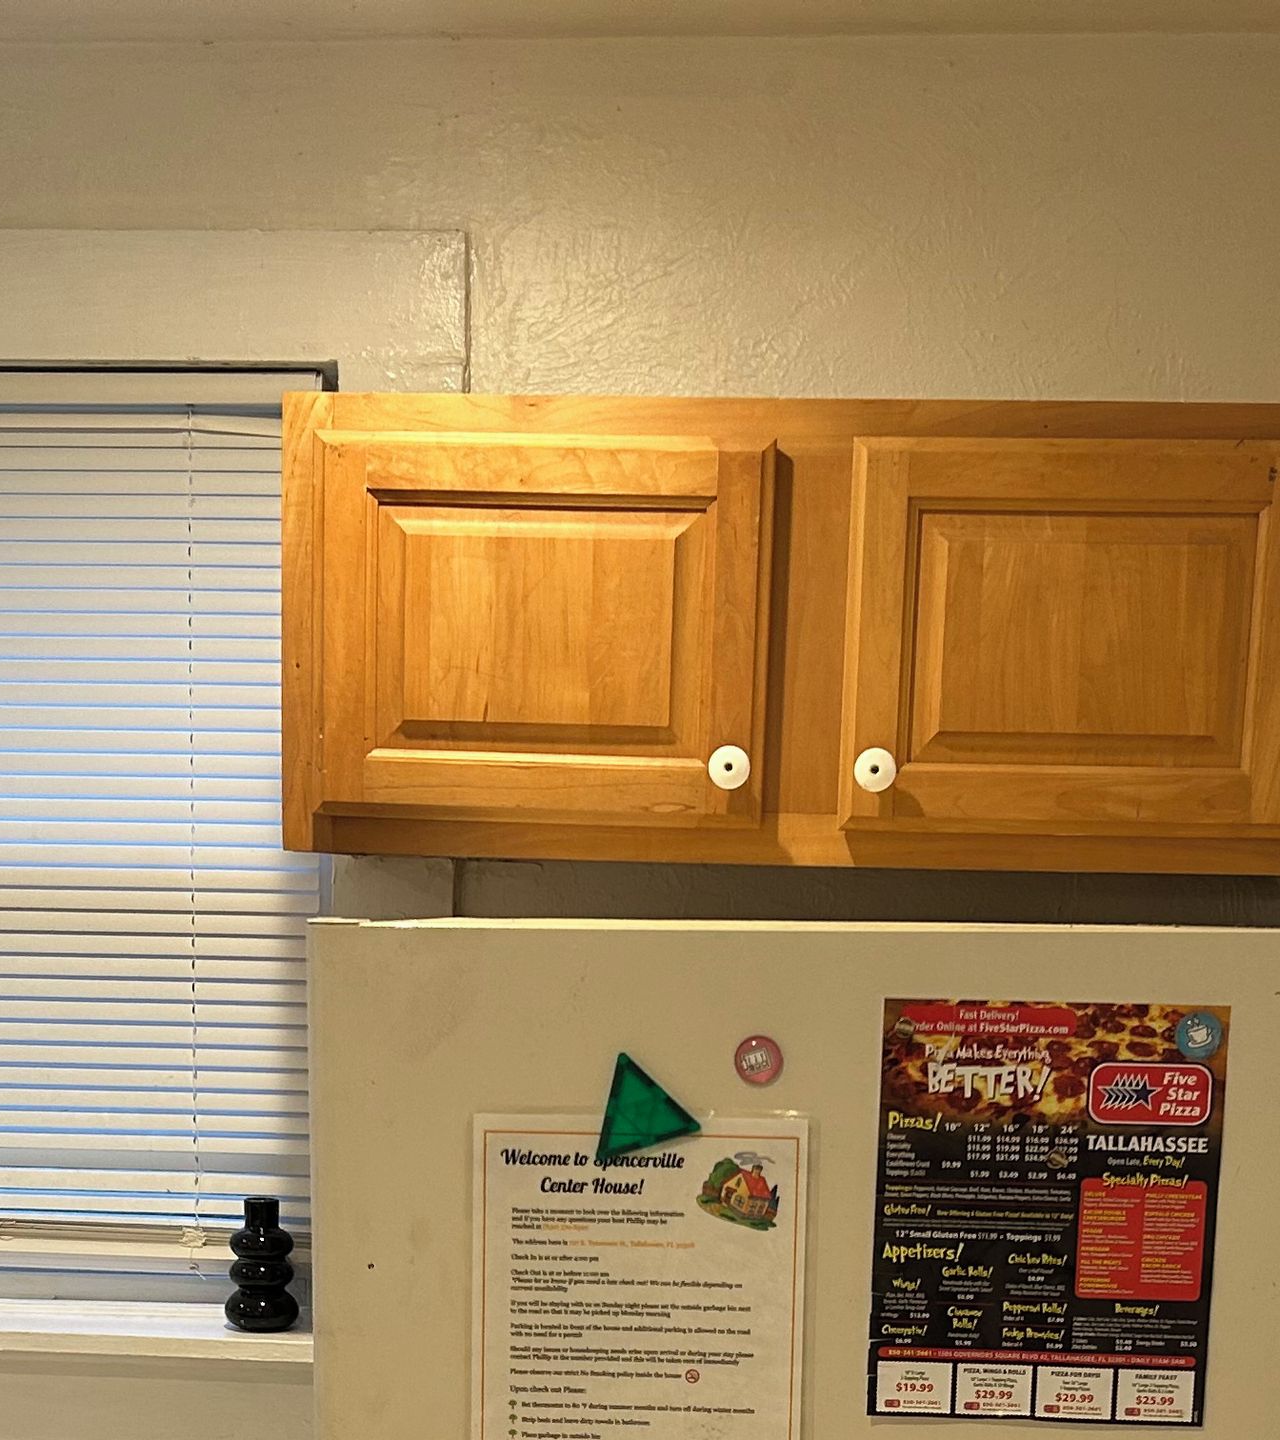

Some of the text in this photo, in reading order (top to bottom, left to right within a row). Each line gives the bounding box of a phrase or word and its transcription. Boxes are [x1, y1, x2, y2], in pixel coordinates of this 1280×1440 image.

[959, 1009, 1019, 1022] Fast Delivery!
[936, 1021, 965, 1032] Online
[968, 1022, 977, 1032] at
[979, 1022, 1068, 1034] FiveStarPizza.com
[955, 1043, 993, 1060] Makes
[994, 1044, 1052, 1064] Everything
[927, 1062, 1052, 1101] BETTER!
[1163, 1072, 1198, 1086] Five
[1166, 1087, 1201, 1101] Star
[1159, 1102, 1201, 1117] Pizza
[888, 1111, 943, 1133] Pizzas!
[974, 1123, 991, 1132] 12"
[1003, 1123, 1020, 1133] 16"
[1086, 1135, 1209, 1154] TALLAHASSEE
[500, 1149, 571, 1166] Welcome
[574, 1152, 589, 1167] to
[1107, 1157, 1125, 1166] Open
[1143, 1155, 1164, 1168] Every
[1164, 1155, 1185, 1168] Day!
[540, 1176, 645, 1195] Center House!
[1102, 1172, 1189, 1189] Specialty Pizzas!
[910, 1204, 932, 1217] Free!
[910, 1230, 931, 1239] Small
[932, 1231, 959, 1239] Gluten
[959, 1231, 977, 1240] Free
[1006, 1233, 1042, 1243] Toppings
[882, 1241, 965, 1263] Appetizers!
[1008, 1252, 1041, 1265] Chicken
[942, 1265, 994, 1279] Garlic Rolls!
[892, 1278, 921, 1291] Wings!
[1003, 1301, 1068, 1316] Pepperoni Rolls!
[1114, 1302, 1160, 1317] Beverages!
[952, 1317, 978, 1331] Rolls!
[1002, 1327, 1025, 1340] Fudge
[1051, 1370, 1069, 1378] PIZZA
[895, 1382, 934, 1393] $19.99
[974, 1389, 1013, 1400] $29.99
[1055, 1392, 1094, 1403] $29.99
[1135, 1395, 1175, 1406] $25.99
